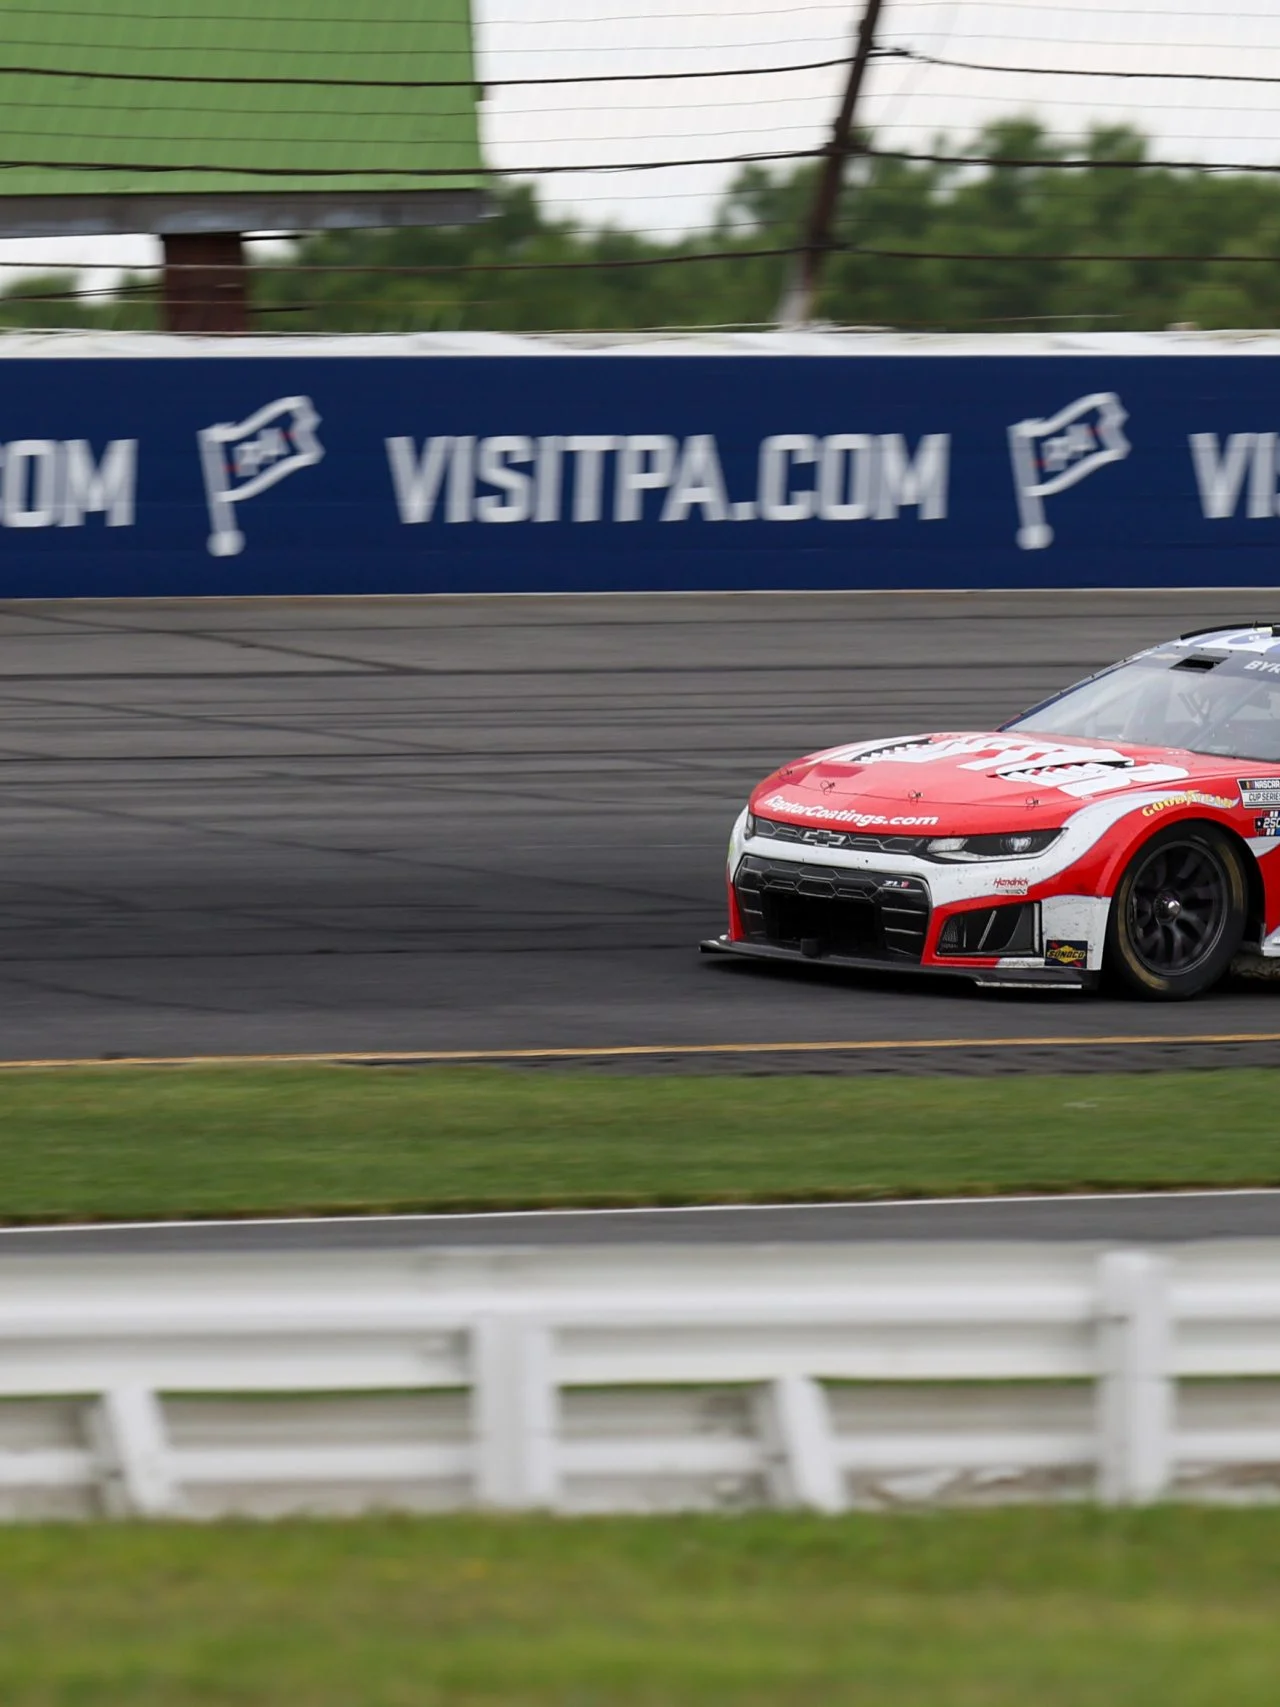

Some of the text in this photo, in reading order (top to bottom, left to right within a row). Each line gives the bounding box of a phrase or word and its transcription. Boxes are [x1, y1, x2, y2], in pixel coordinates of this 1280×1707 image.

[0, 438, 139, 528] OM
[384, 433, 952, 524] VISITPA.COM
[1249, 793, 1261, 801] CUP
[1253, 780, 1280, 789] NASCAR
[764, 795, 939, 827] RaptorCoatings.com
[1142, 790, 1233, 817] GOODYEAR
[1047, 950, 1086, 960] SONOCO
